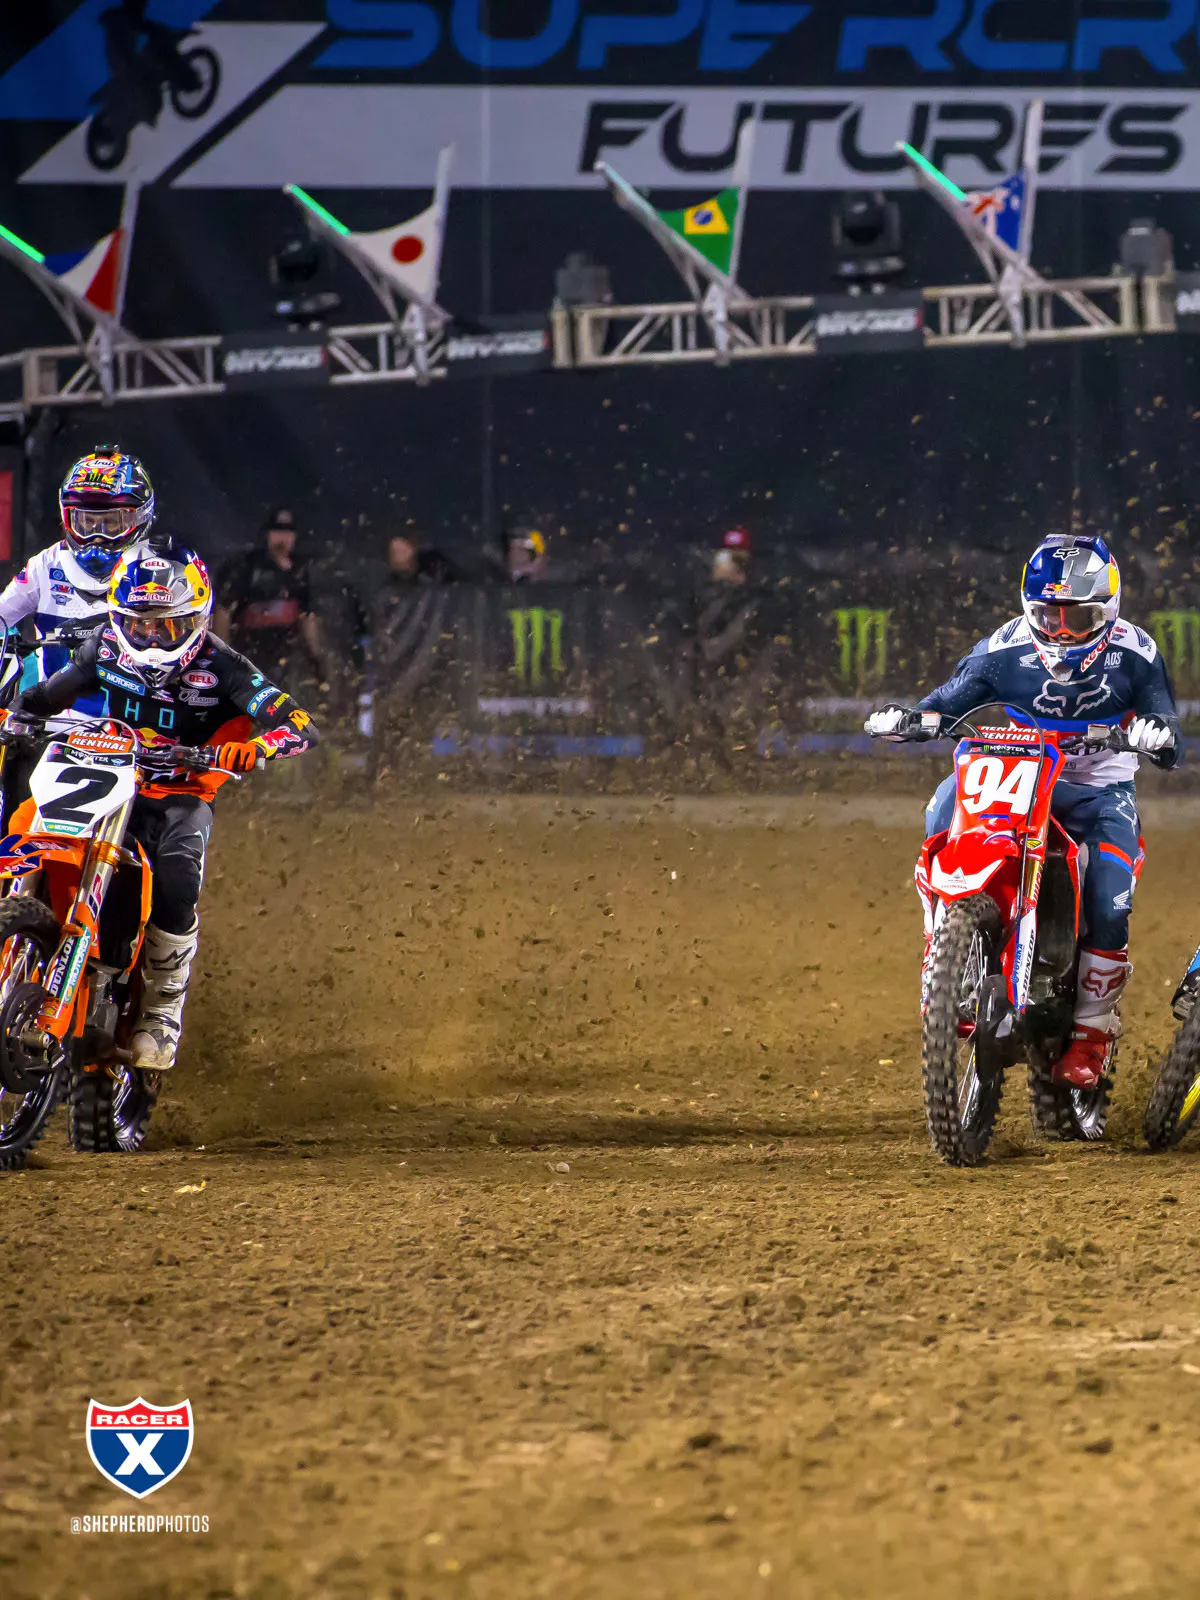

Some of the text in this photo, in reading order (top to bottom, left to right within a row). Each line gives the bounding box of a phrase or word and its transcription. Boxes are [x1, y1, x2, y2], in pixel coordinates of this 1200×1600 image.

[579, 102, 1190, 174] FUTURES
[1104, 651, 1123, 666] AOS
[106, 672, 141, 692] MOTOREX
[188, 673, 213, 684] BELL
[71, 738, 127, 751] RENTHAL
[989, 744, 1025, 753] MONSTER
[39, 766, 119, 825] 2
[960, 756, 1040, 815] 94
[70, 933, 92, 986] MOTOREX
[1022, 928, 1036, 991] DUNLOP
